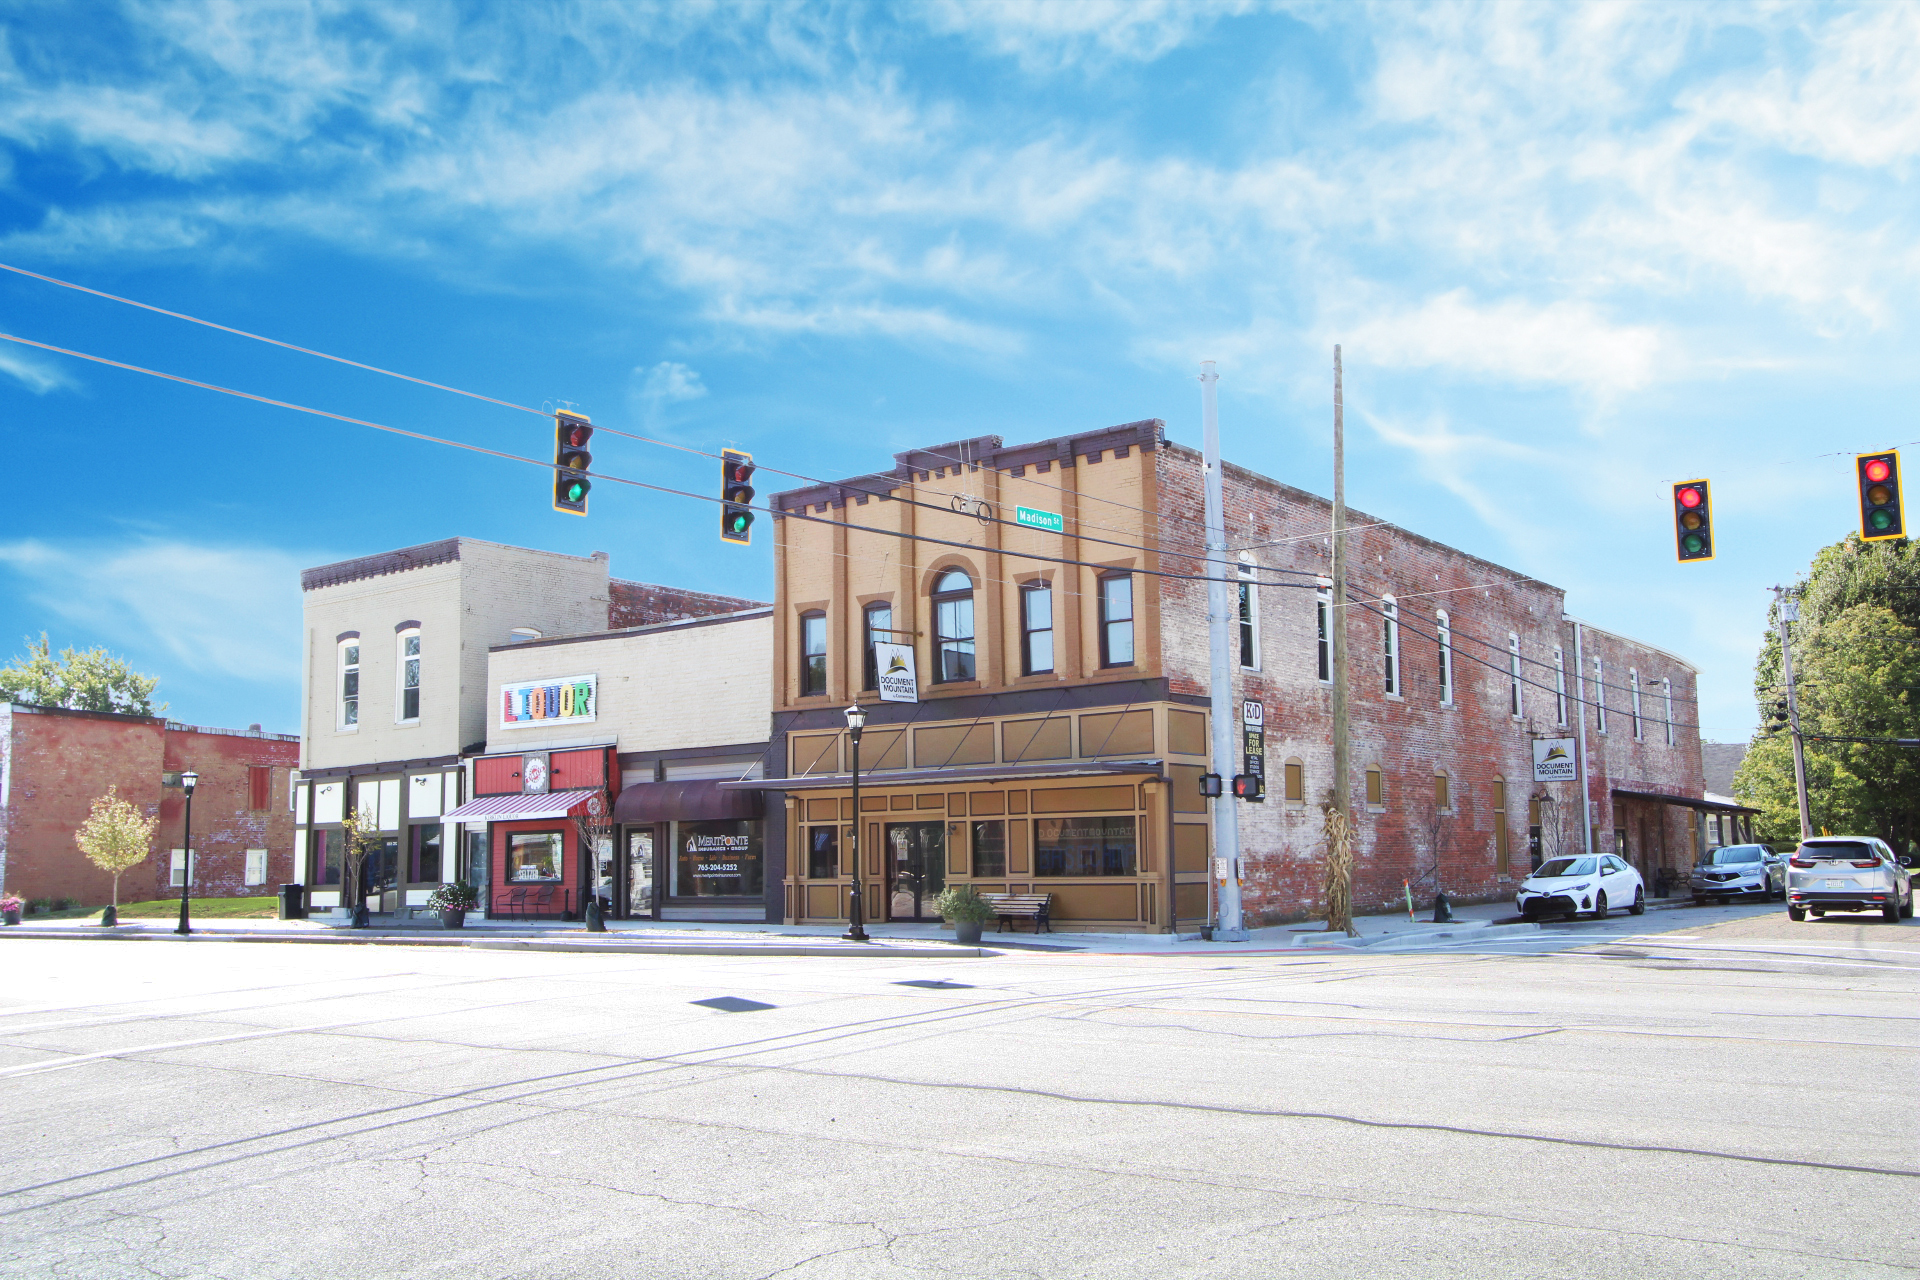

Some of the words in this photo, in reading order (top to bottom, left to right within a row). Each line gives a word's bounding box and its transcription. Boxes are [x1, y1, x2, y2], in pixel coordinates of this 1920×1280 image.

[1019, 510, 1052, 526] Madison
[1053, 517, 1060, 526] St
[881, 676, 914, 686] DOCUMENT
[884, 685, 914, 694] MOUNTAIN
[504, 683, 589, 722] LIQUOR
[1249, 739, 1259, 747] FOR
[1246, 746, 1262, 755] LEASE
